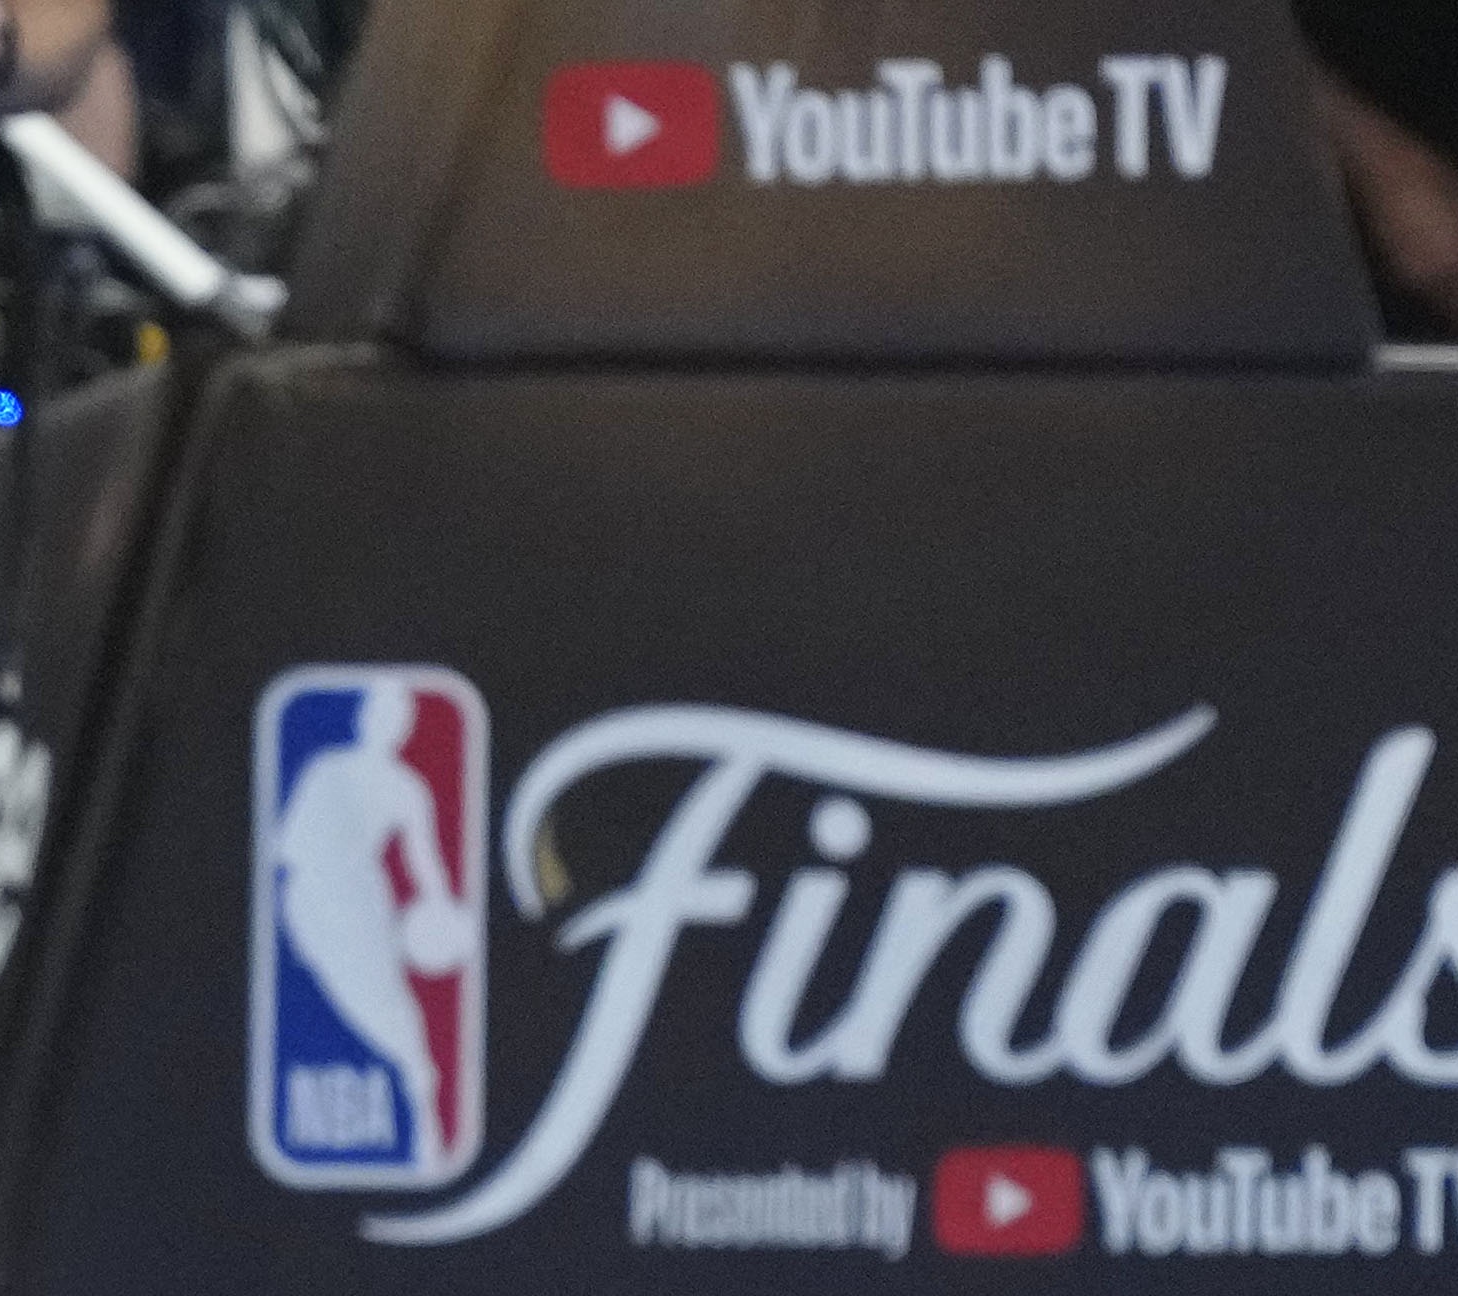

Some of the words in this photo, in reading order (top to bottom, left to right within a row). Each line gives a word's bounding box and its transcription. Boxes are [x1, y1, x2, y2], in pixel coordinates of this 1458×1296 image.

[726, 53, 1097, 183] YouTube
[1098, 54, 1227, 181] TV
[1089, 1143, 1402, 1258] YouTube
